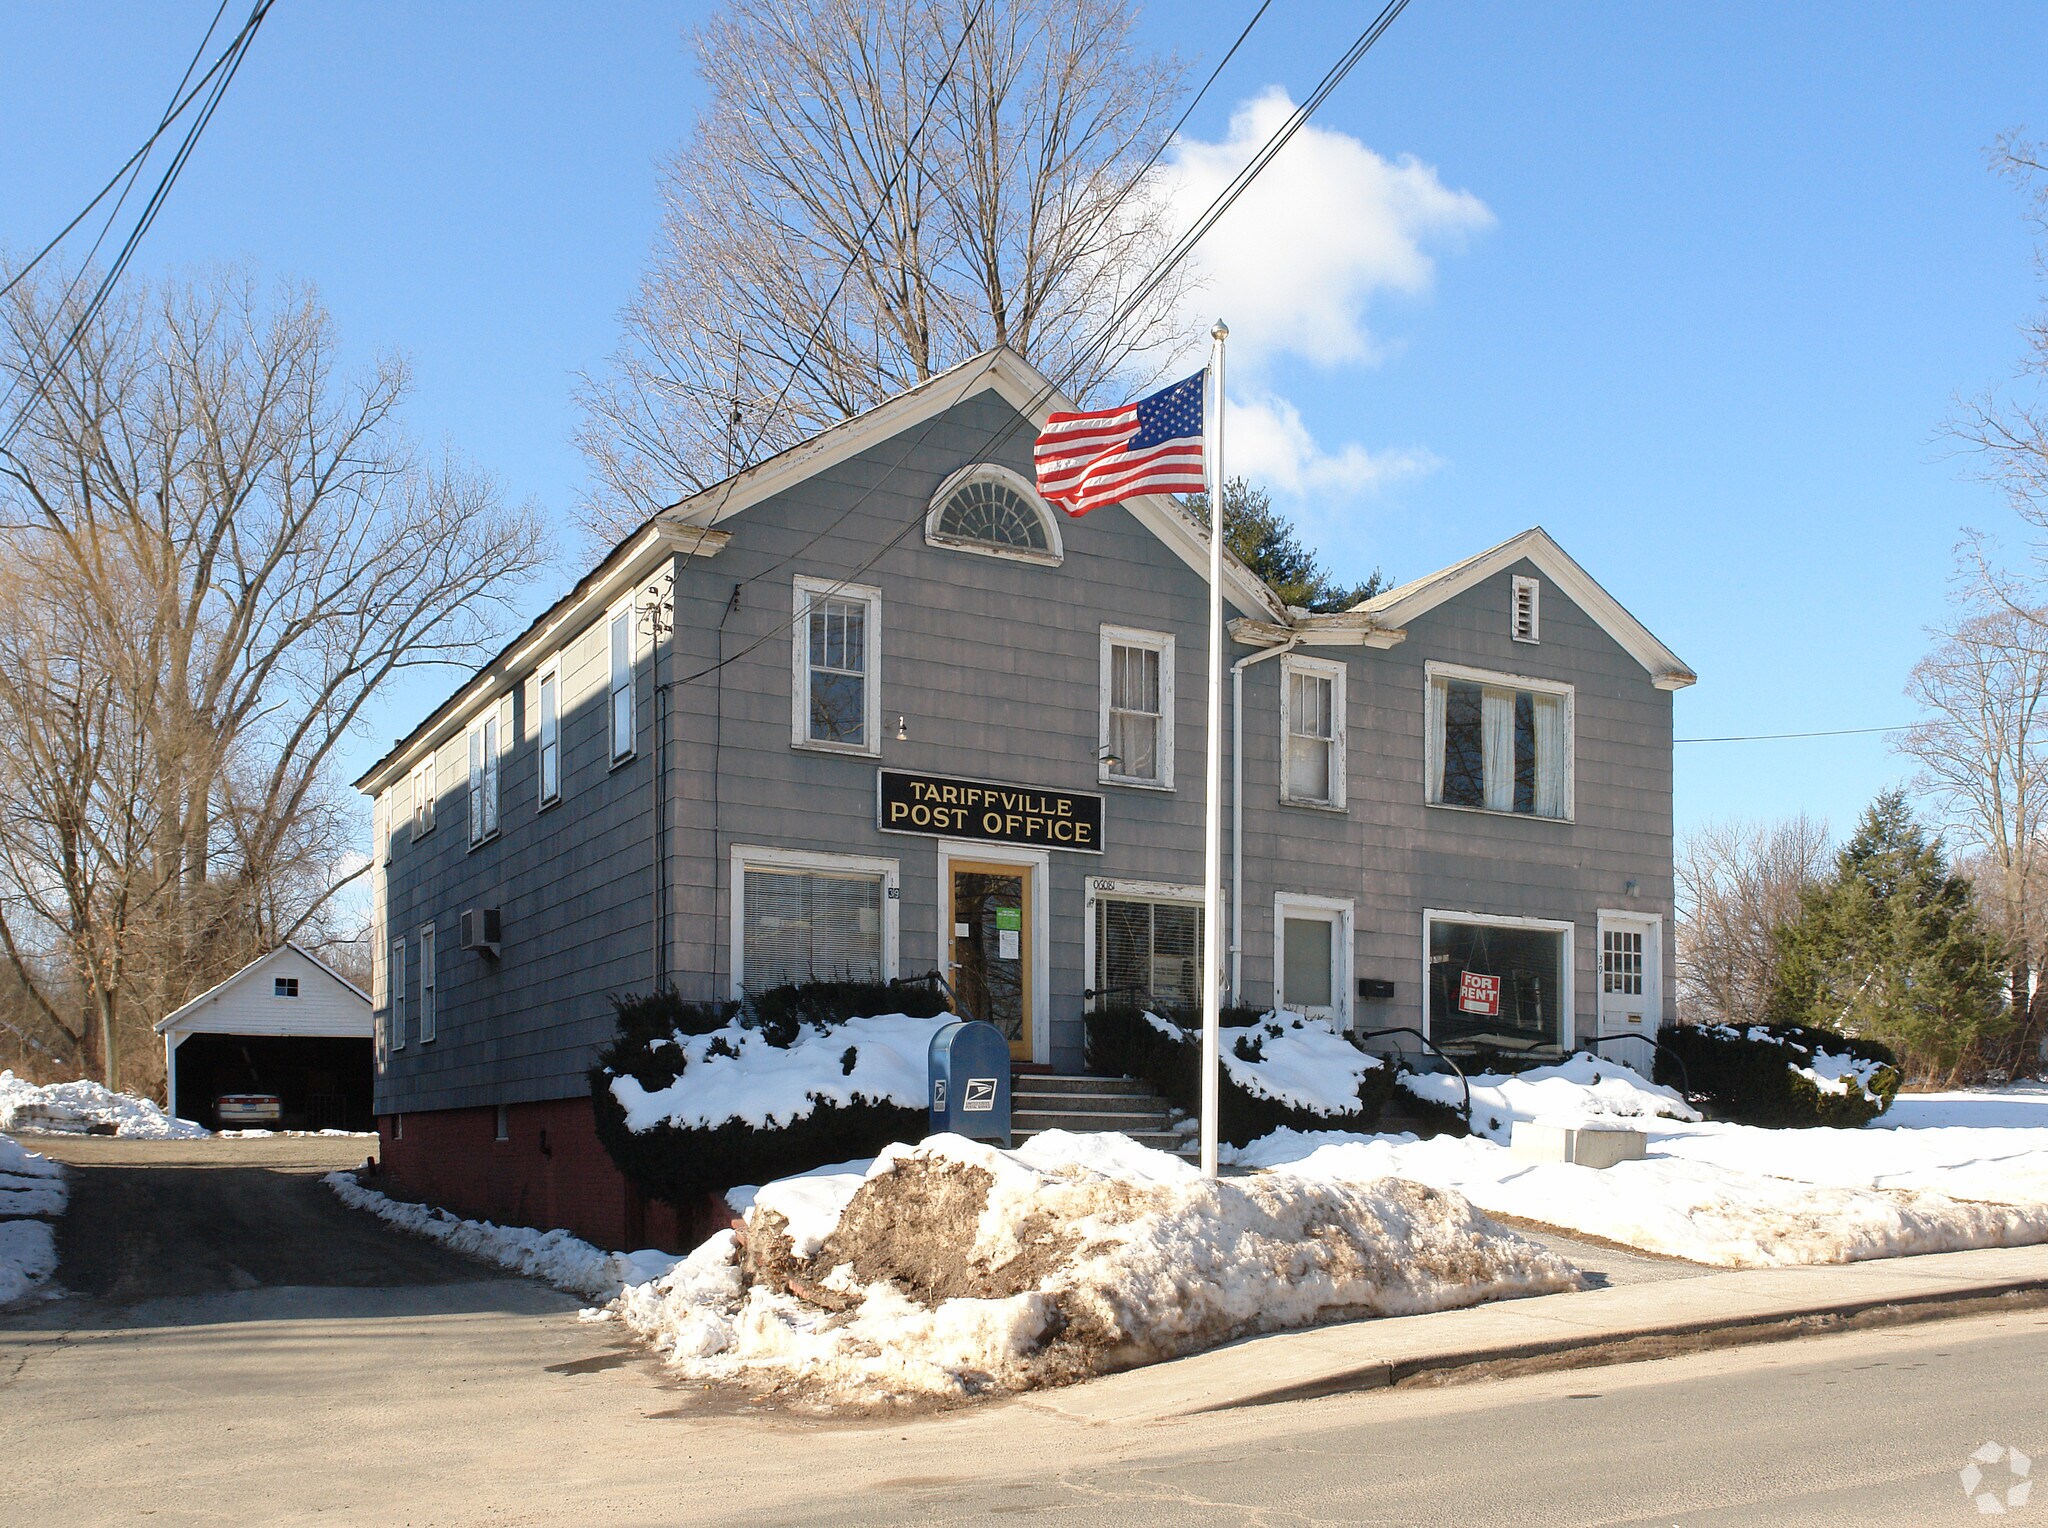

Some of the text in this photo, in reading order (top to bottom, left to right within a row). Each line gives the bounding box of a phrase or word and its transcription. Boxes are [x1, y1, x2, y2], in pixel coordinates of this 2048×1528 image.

[910, 782, 1073, 817] TARIFFVILLE
[891, 801, 1092, 843] POST OFFICE
[888, 887, 899, 899] 39
[1598, 954, 1603, 975] 39
[1465, 974, 1493, 990] FOR
[1461, 985, 1497, 1002] RENT
